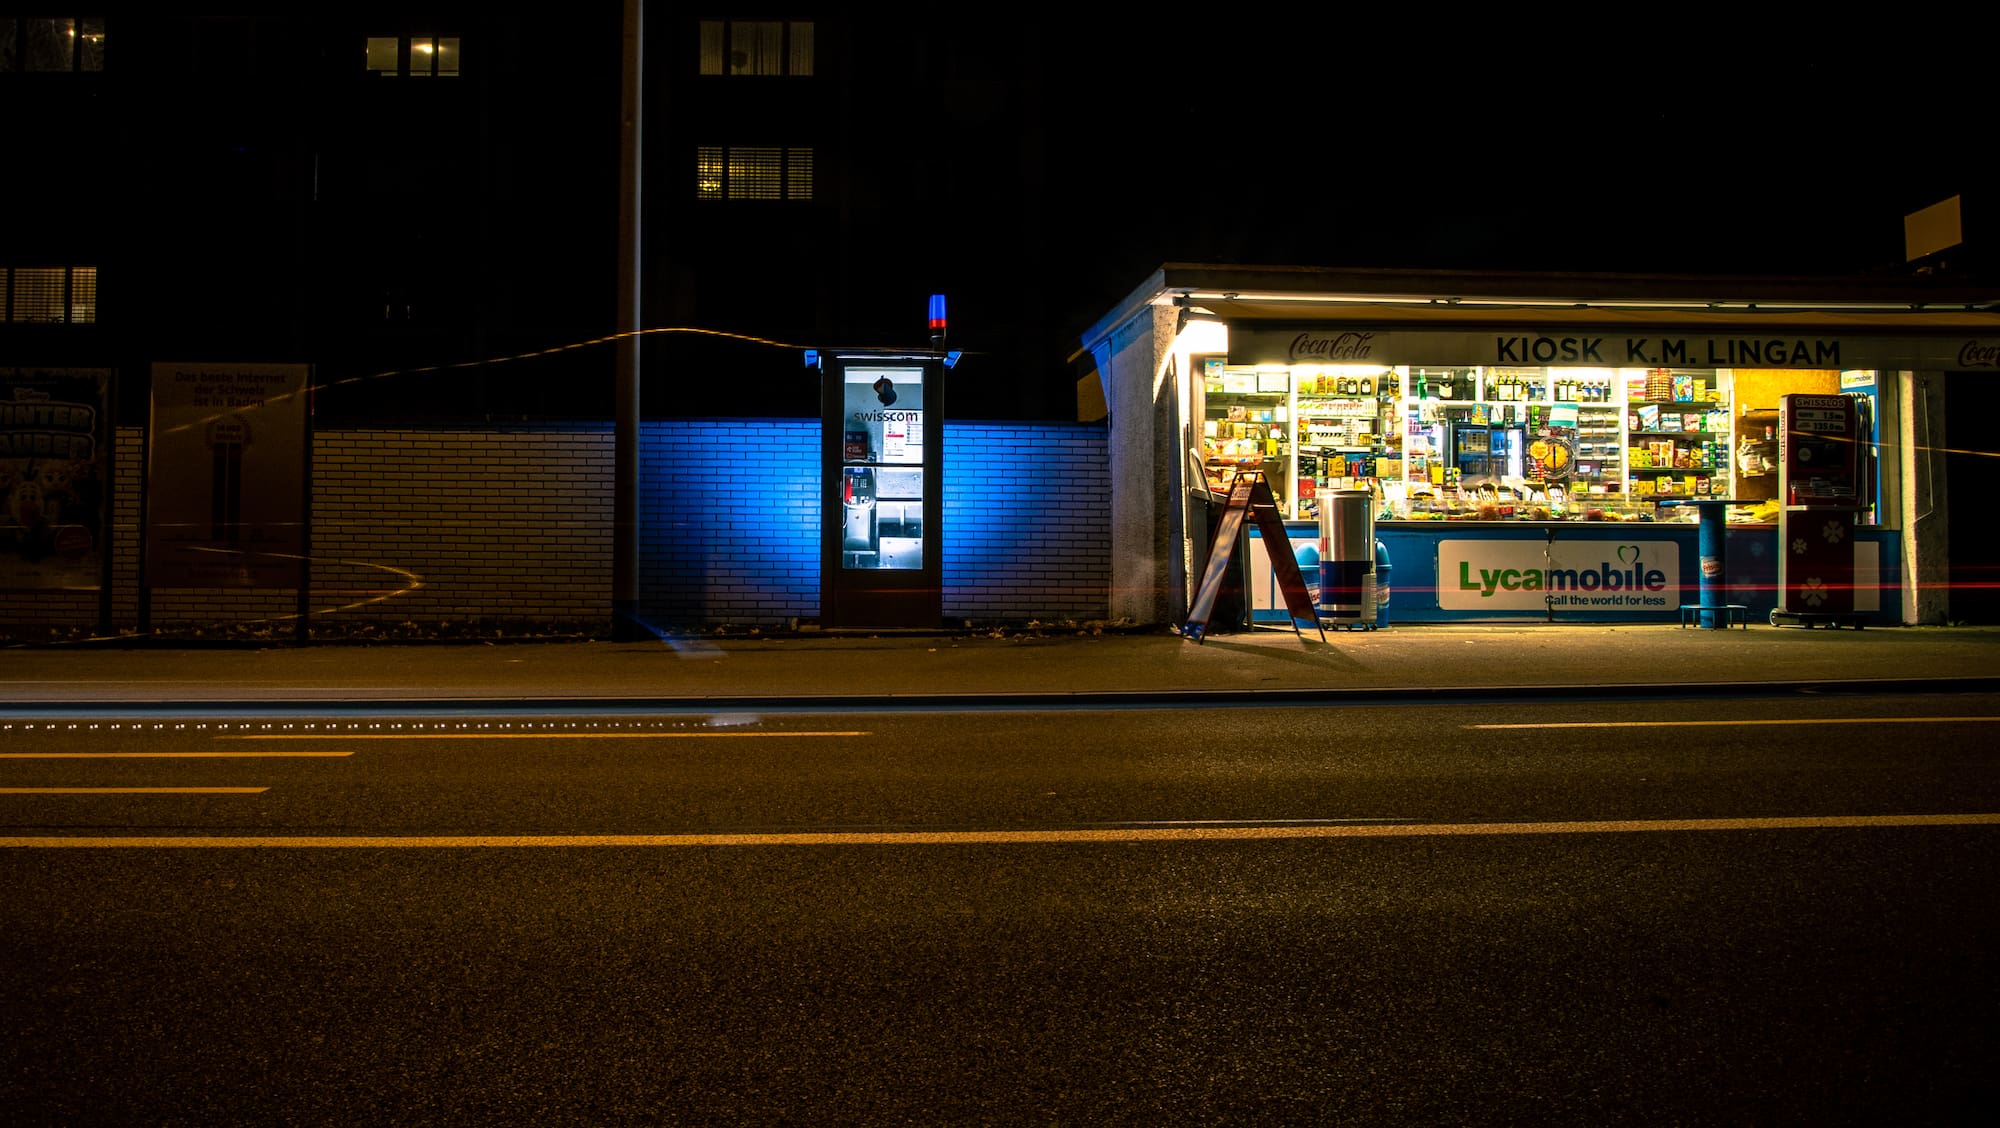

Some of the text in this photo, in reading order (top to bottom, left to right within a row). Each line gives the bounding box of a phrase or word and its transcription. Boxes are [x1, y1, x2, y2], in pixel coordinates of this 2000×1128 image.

[1288, 332, 1376, 361] Coca-Cola
[1497, 337, 1841, 365] KIOSK K.M. LINGAM
[175, 371, 287, 384] Das beste Internet
[194, 384, 265, 395] der Schweiz
[212, 397, 223, 407] in
[227, 397, 265, 407] Baden
[1797, 398, 1844, 408] SWISSLOS
[0, 406, 89, 427] INTER
[853, 409, 918, 422] swisscom
[1459, 561, 1666, 598] Lycamobile
[1545, 595, 1666, 605] Call the world for less
